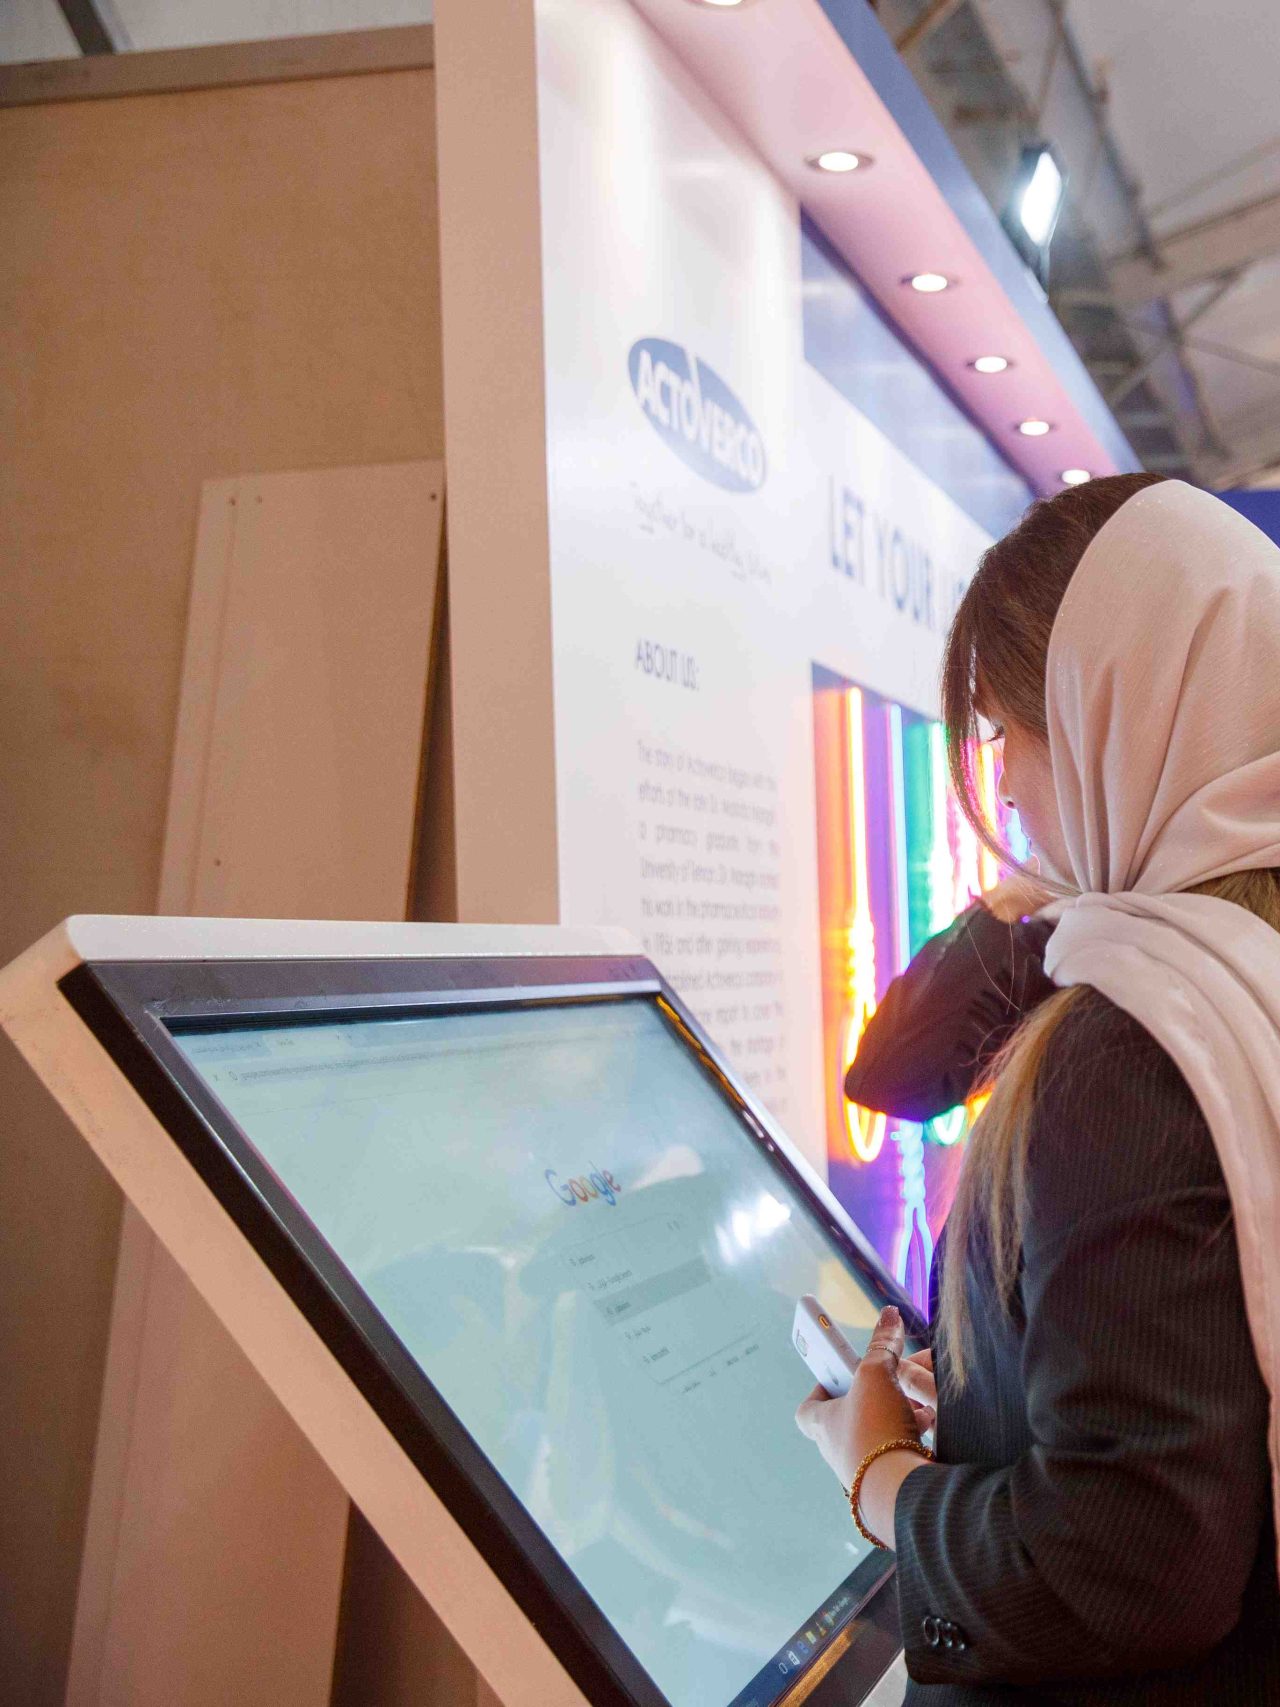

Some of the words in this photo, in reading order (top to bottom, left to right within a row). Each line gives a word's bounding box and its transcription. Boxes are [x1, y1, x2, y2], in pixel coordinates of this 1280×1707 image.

[827, 474, 864, 587] LET
[636, 637, 678, 684] ABOUT
[544, 1160, 621, 1206] Google
